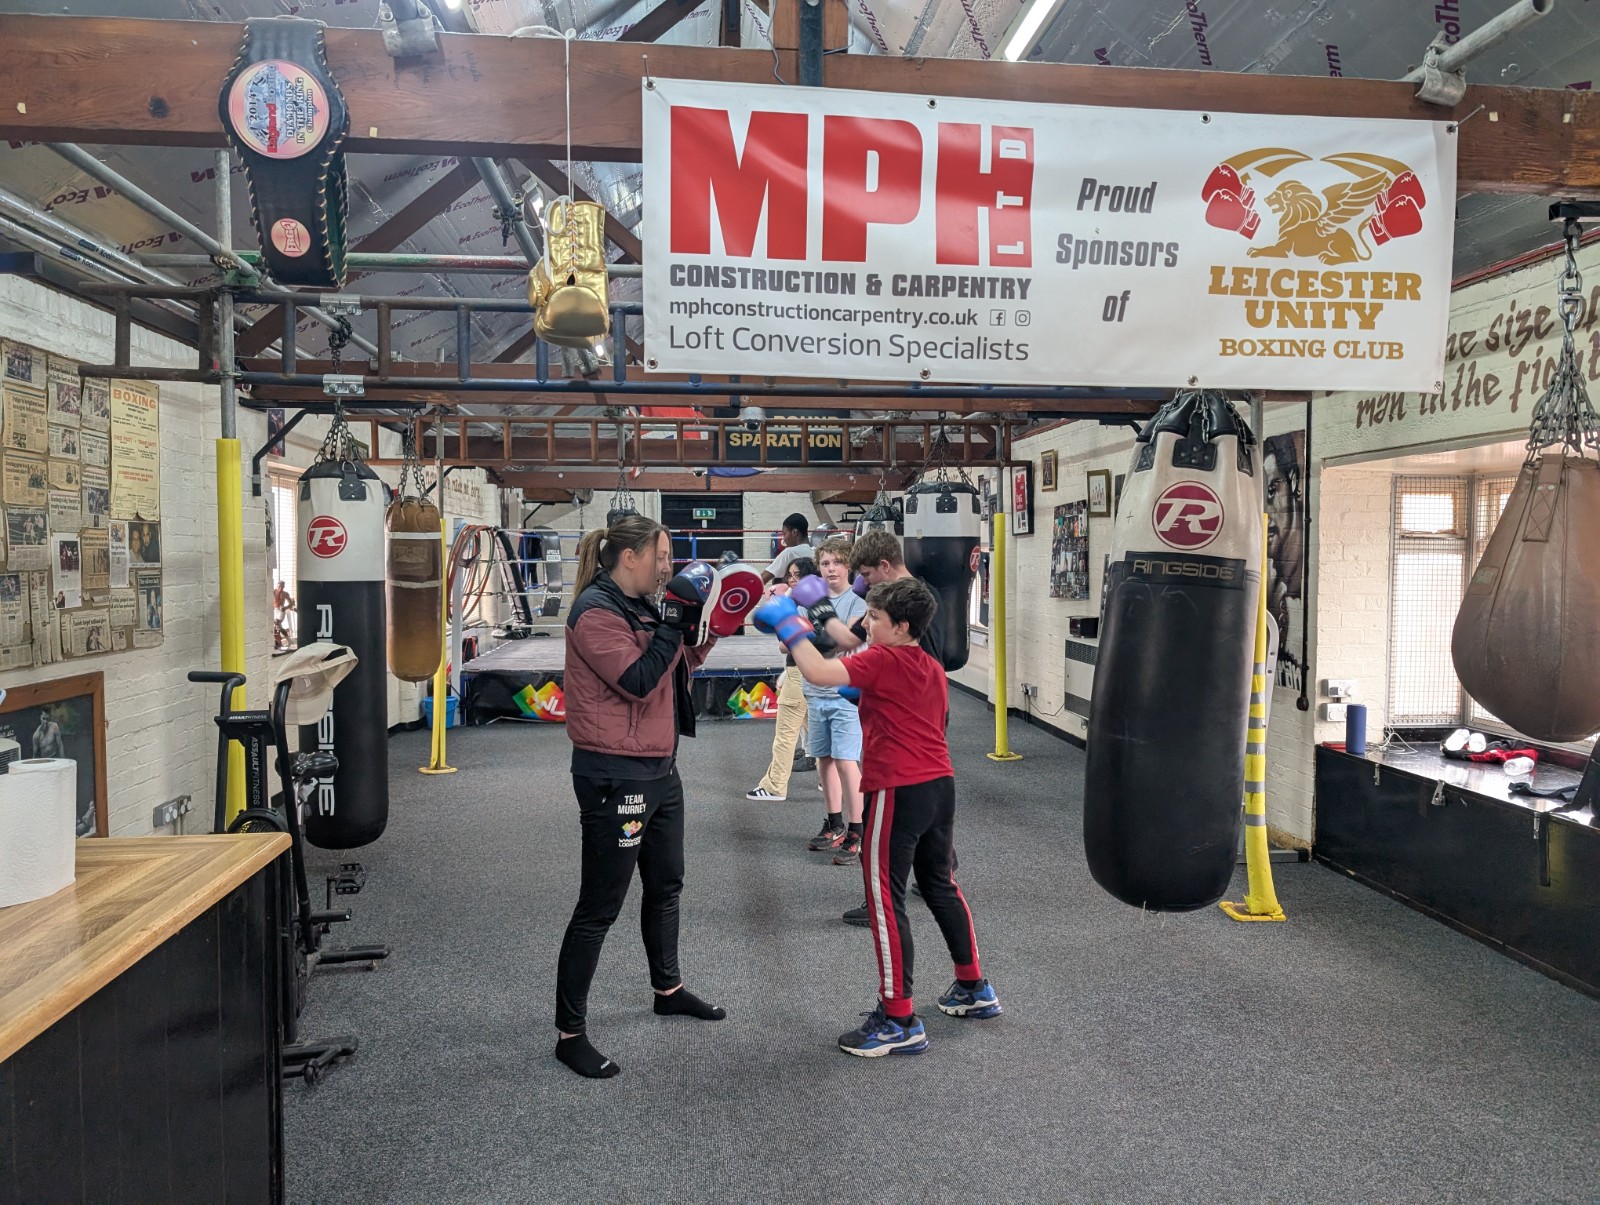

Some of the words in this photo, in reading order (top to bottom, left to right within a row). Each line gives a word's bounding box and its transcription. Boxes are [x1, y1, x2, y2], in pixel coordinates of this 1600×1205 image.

[295, 77, 304, 102] RING
[249, 93, 257, 121] 2014
[285, 82, 294, 137] DIAMONDS
[296, 107, 305, 128] THE
[305, 89, 315, 133] Champion
[296, 132, 305, 143] IN
[384, 160, 441, 182] EcoTherm
[670, 105, 1034, 268] MPH
[996, 138, 1027, 256] LTD
[1077, 177, 1157, 214] Proud
[1056, 233, 1179, 270] Sponsors
[670, 263, 856, 296] CONSTRUCTION
[866, 273, 883, 296] &
[891, 273, 1031, 300] CARPENTRY
[1208, 266, 1422, 301] LEICESTER
[669, 300, 978, 328] mphconstructioncarpentry.co.uk
[1102, 289, 1131, 323] of
[1244, 300, 1383, 330] UNITY
[669, 325, 725, 350] Loft
[732, 326, 881, 357] Conversion
[888, 332, 1029, 363] Specialists
[1485, 299, 1555, 358] size
[1218, 338, 1327, 359] BOXING
[1333, 340, 1404, 360] CLUB
[113, 388, 157, 410] BOXING
[1356, 392, 1407, 429] man
[1451, 361, 1502, 411] the
[1132, 559, 1235, 581] RINGSIDE
[617, 803, 647, 815] MURNEY
[624, 793, 644, 804] TEAM
